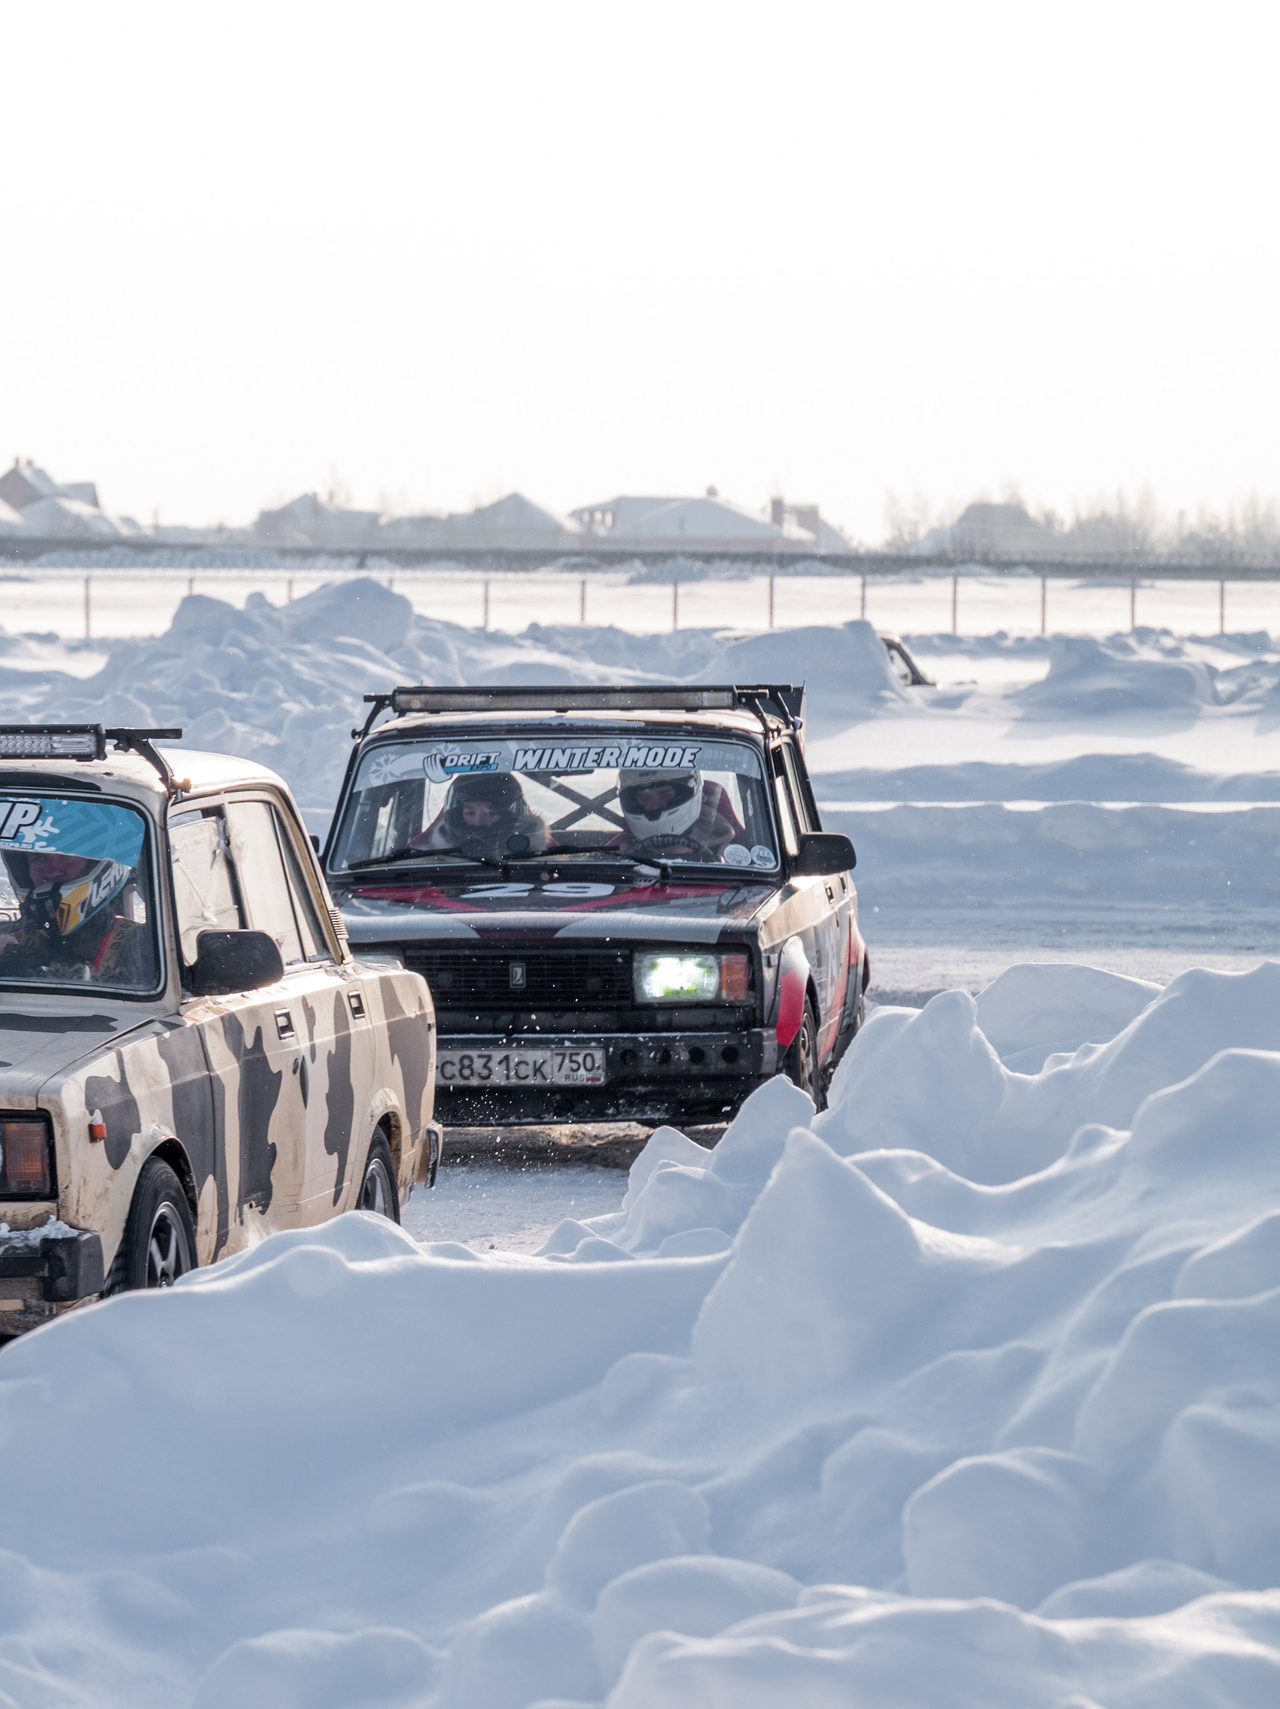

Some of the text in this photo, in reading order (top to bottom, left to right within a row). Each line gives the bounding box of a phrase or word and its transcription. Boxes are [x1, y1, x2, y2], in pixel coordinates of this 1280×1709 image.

[445, 751, 502, 767] DRIFT
[513, 746, 702, 770] WINTER MODE
[460, 882, 615, 898] 29
[554, 1052, 595, 1073] 750
[564, 1074, 586, 1082] RUS
